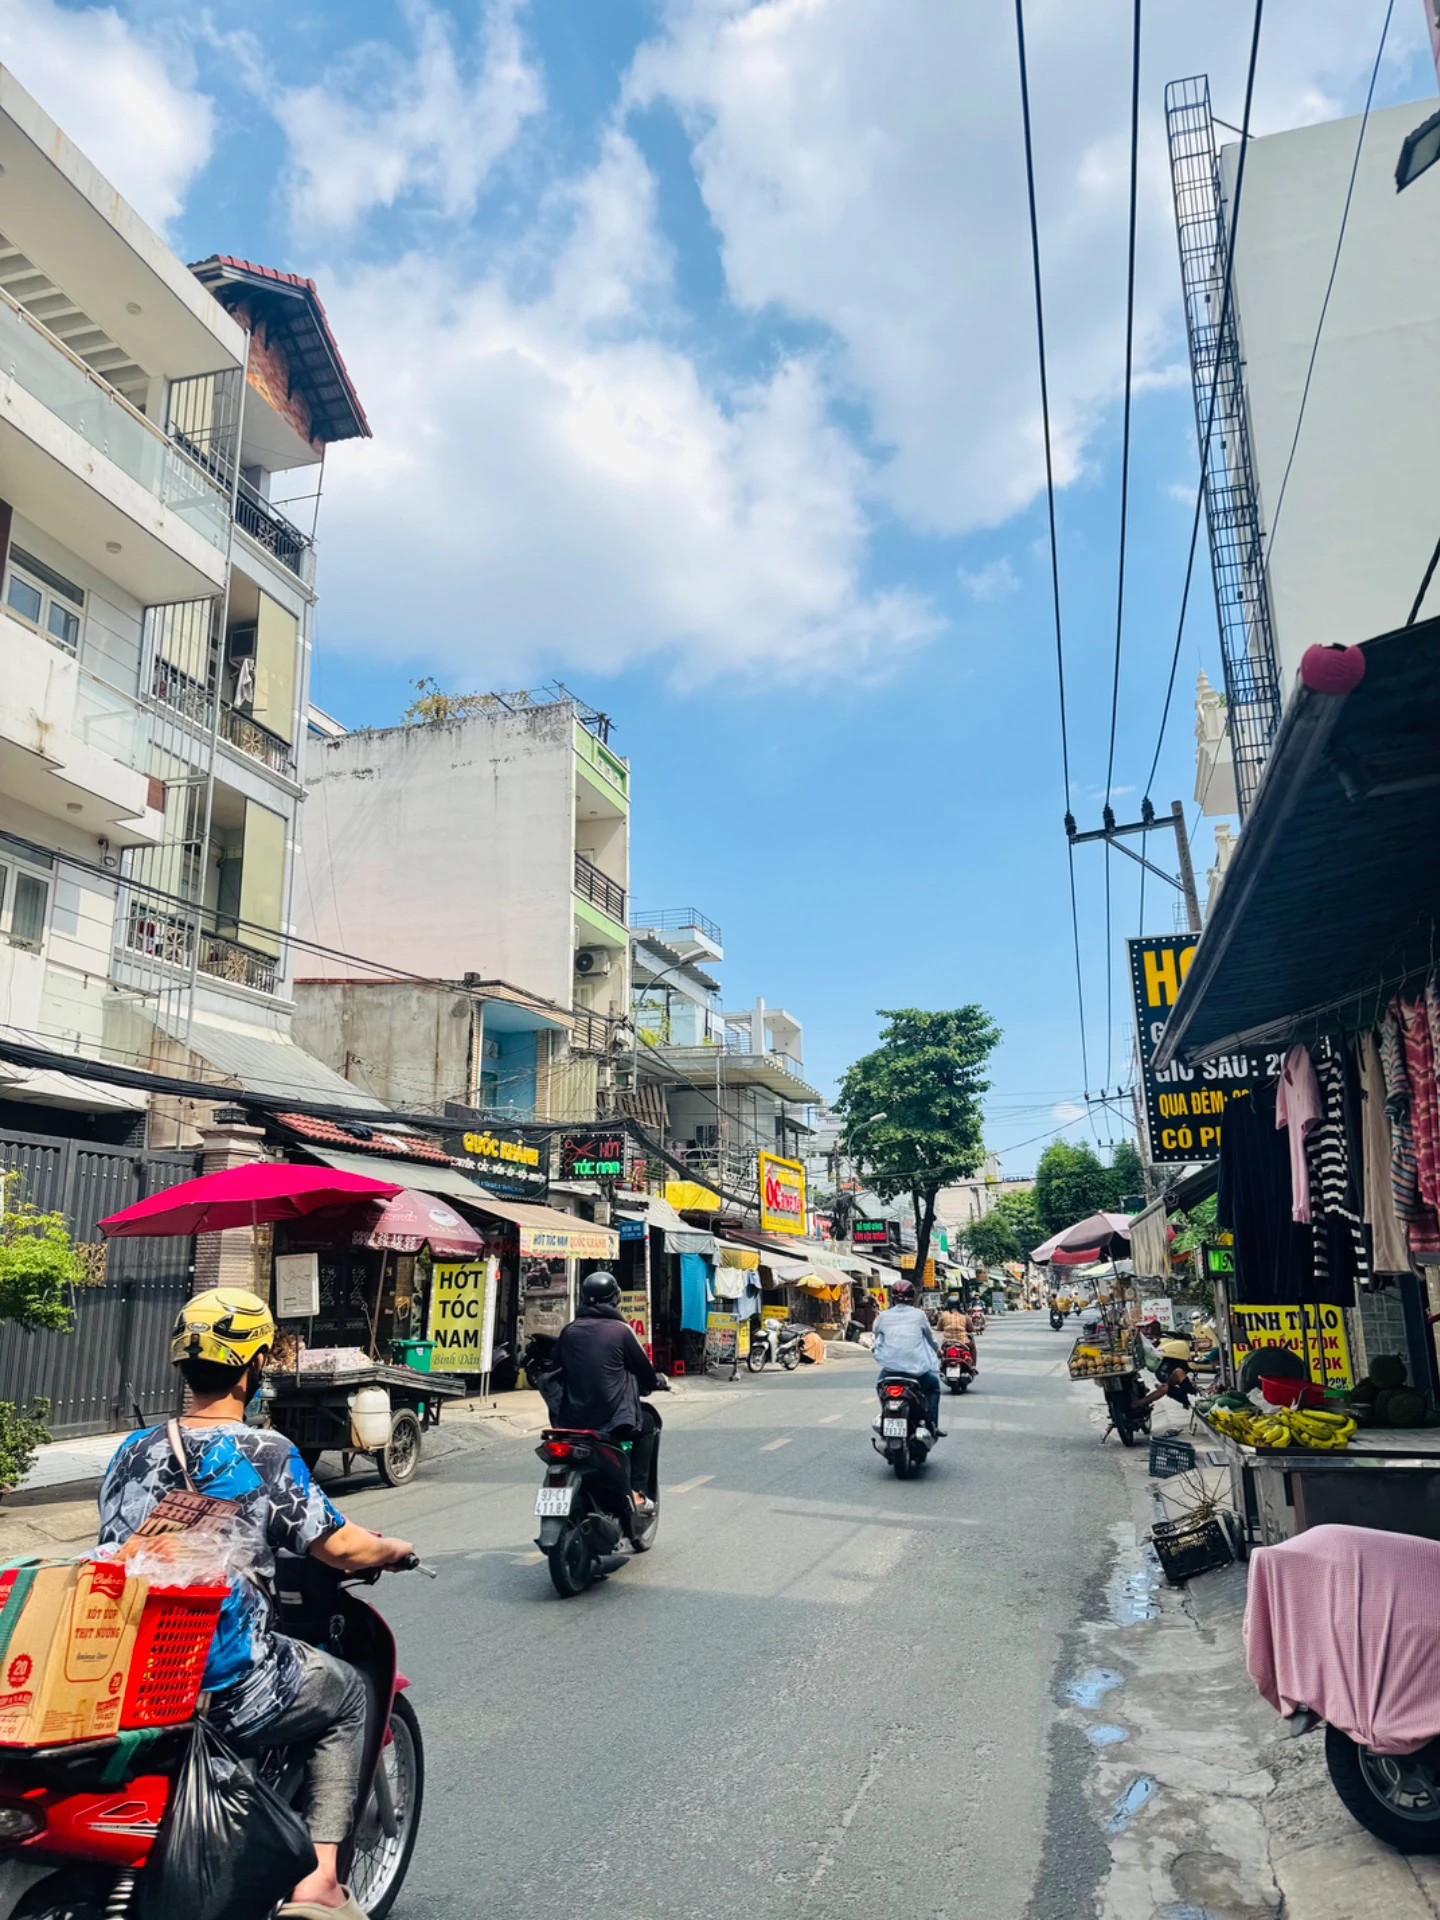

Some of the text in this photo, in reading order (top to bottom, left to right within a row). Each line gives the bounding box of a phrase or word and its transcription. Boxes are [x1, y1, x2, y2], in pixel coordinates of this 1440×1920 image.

[1159, 1093, 1188, 1119] QUA
[463, 1131, 499, 1158] QUỐC
[599, 1138, 620, 1158] HỚT
[1162, 1124, 1193, 1149] CÓ
[573, 1159, 620, 1175] TÓC NAM
[439, 1264, 483, 1290] HỚT
[438, 1293, 479, 1319] TÓC
[434, 1329, 479, 1348] NAM
[13, 1660, 28, 1676] 20
